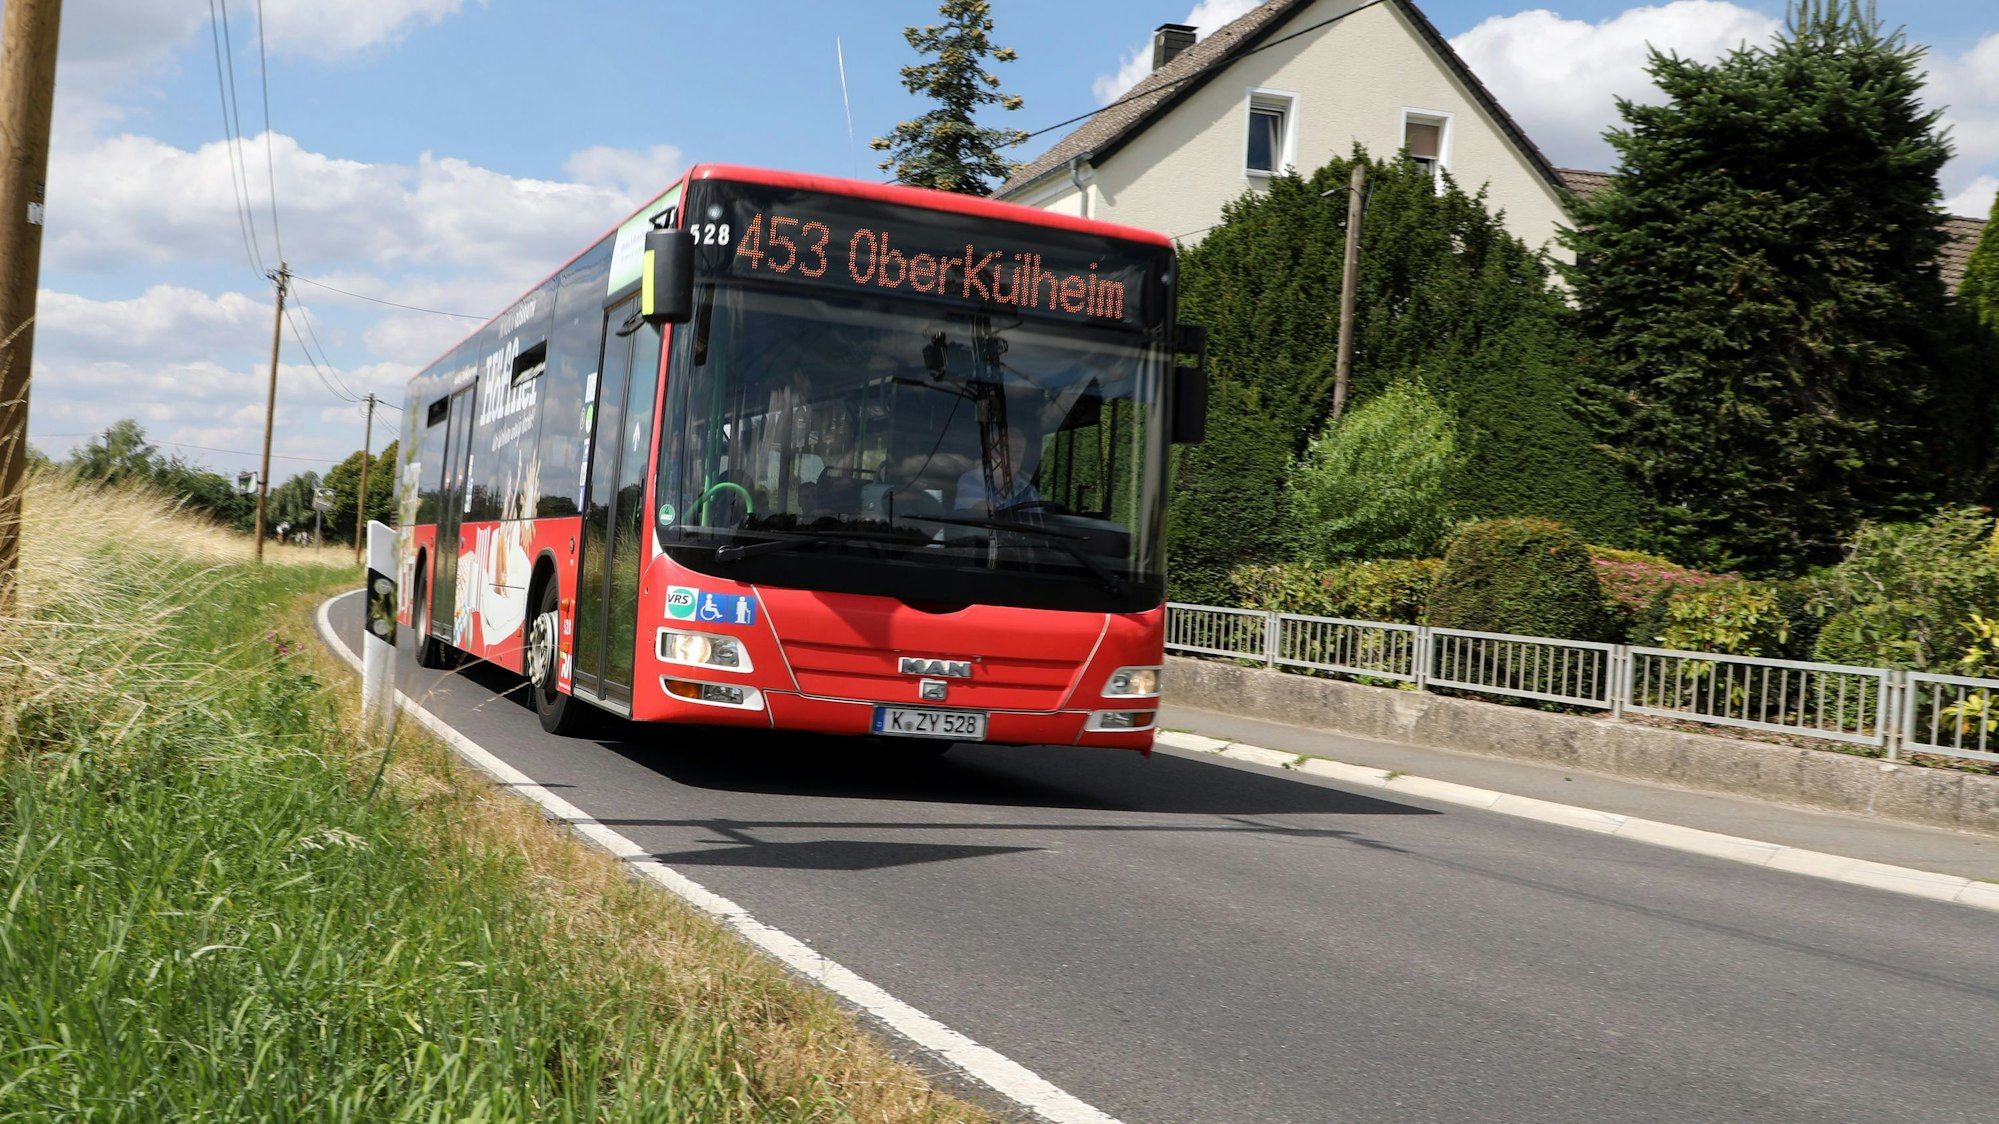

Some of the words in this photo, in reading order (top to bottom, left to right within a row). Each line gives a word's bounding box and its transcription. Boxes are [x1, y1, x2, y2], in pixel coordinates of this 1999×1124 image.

[690, 223, 731, 246] 528
[736, 212, 830, 277] 453
[667, 593, 689, 605] VRS
[898, 656, 972, 678] MAN
[891, 711, 905, 730] K
[916, 712, 940, 732] ZY
[943, 714, 977, 734] 528
